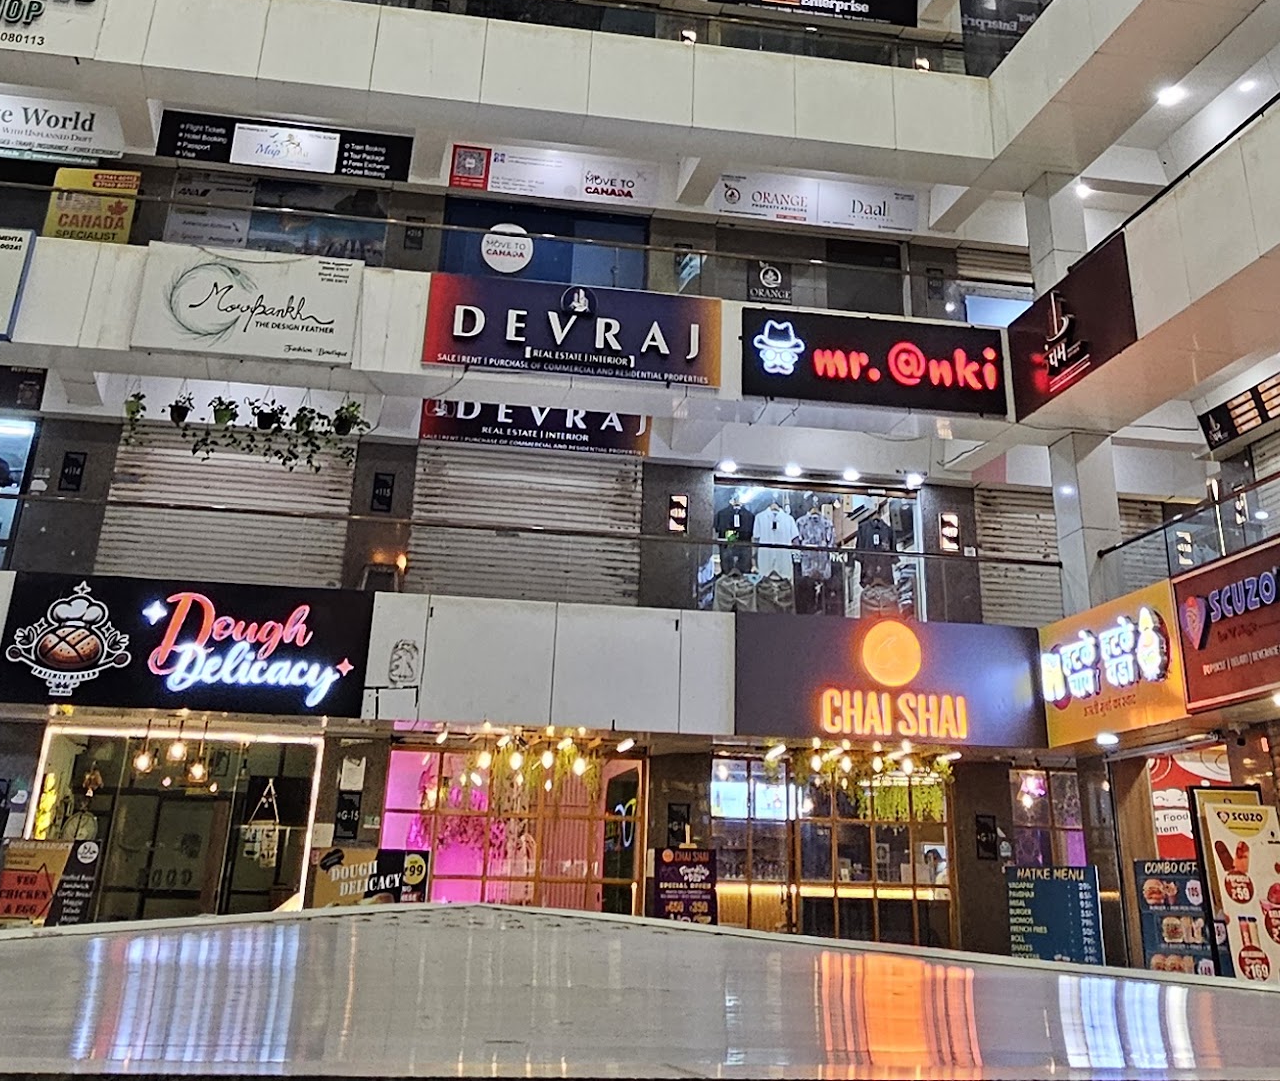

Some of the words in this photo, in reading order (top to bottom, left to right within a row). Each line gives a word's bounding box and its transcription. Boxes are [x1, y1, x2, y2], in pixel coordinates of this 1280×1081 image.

[22, 106, 96, 132] World
[621, 180, 634, 188] TO
[586, 187, 633, 198] CANADA
[752, 191, 807, 207] ORANGE
[58, 214, 124, 230] CANADA
[486, 248, 525, 259] CANADA
[512, 242, 526, 250] TO
[255, 320, 270, 328] THE
[300, 325, 334, 334] FEATHER
[452, 304, 700, 360] DEVRAJ
[437, 352, 456, 362] SALE
[460, 355, 482, 364] RENT
[489, 358, 528, 369] PURCHASE
[531, 361, 541, 369] OF
[544, 362, 594, 375] COMMERCIAL
[597, 367, 613, 376] AND
[616, 368, 662, 380] RESIDENTIAL
[664, 373, 708, 384] PROPERTIES
[813, 347, 882, 383] mr.
[1208, 567, 1277, 623] SCUZO
[148, 592, 313, 676] Dough
[167, 642, 341, 706] Delicacy
[822, 688, 892, 735] CHAI
[897, 693, 967, 739] SHAI
[1163, 813, 1188, 822] Food
[331, 860, 377, 881] DOUGH
[1017, 868, 1050, 879] HATKE
[1053, 868, 1084, 881] MENU
[1145, 862, 1178, 874] COMBO
[340, 873, 402, 896] DELICACY
[0, 889, 48, 899] CHICKEN
